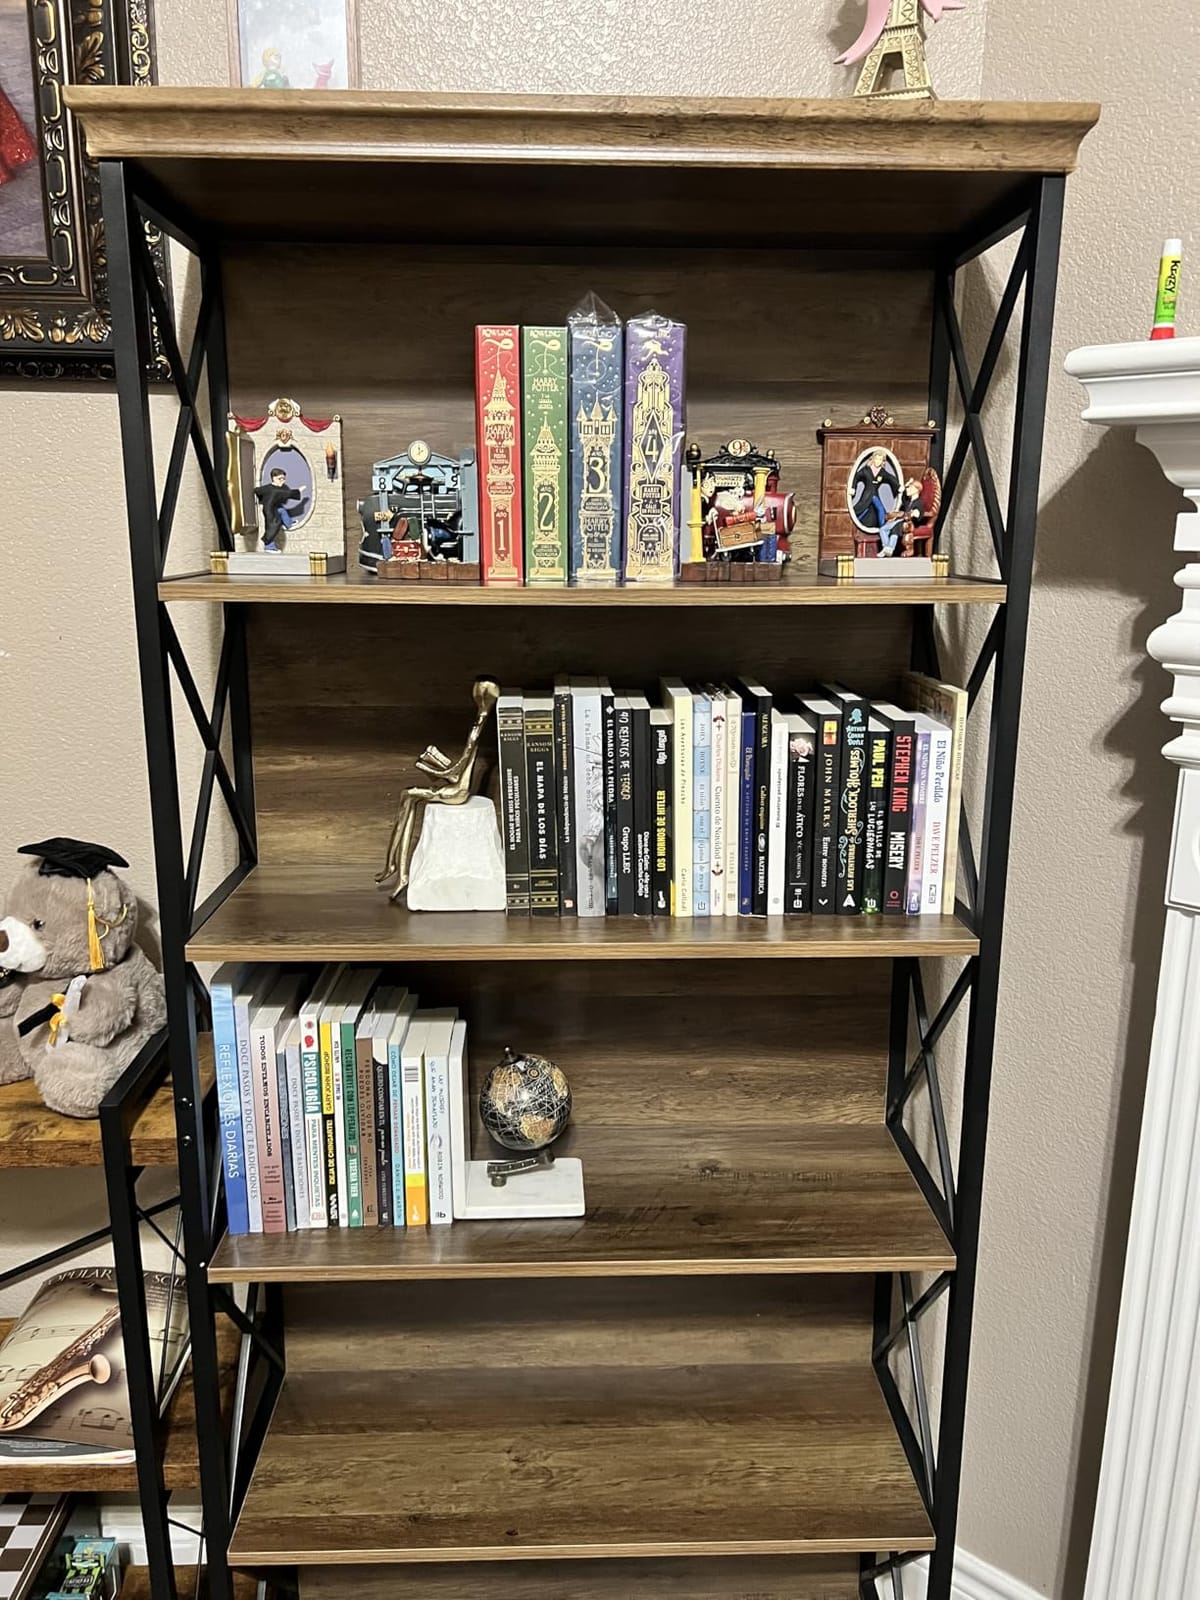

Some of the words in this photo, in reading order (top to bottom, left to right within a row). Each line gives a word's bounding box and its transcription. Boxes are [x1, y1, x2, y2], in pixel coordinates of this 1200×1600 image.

[533, 377, 558, 385] HARRY
[645, 435, 659, 462] 4
[378, 477, 386, 490] 8
[451, 474, 458, 487] 9
[588, 457, 606, 493] 3
[538, 493, 554, 531] 2
[497, 519, 506, 551] 1
[584, 709, 591, 718] La
[607, 719, 614, 727] EL
[618, 711, 629, 723] 40
[619, 726, 630, 757] RELATOS
[761, 713, 769, 748] ALFAGUARA
[872, 739, 886, 766] PAUL
[922, 743, 930, 751] EL
[937, 740, 947, 749] El
[536, 761, 544, 772] EL
[607, 766, 614, 775] LA
[619, 760, 630, 769] DE
[656, 752, 668, 765] Olga
[823, 752, 833, 783] JOHN
[846, 749, 861, 788] HOLMES
[893, 735, 912, 783] STEPHEN
[921, 752, 929, 768] NIÑO
[936, 751, 946, 770] Niño
[585, 768, 593, 785] debe
[680, 769, 687, 777] de
[796, 765, 806, 797] FLORES
[871, 768, 885, 788] PEN
[536, 775, 546, 800] MAPA
[620, 773, 631, 800] TERROR
[918, 780, 927, 804] NOMBRE
[933, 772, 945, 803] Perdido
[537, 803, 546, 815] DE
[656, 790, 666, 815] HITLER
[714, 785, 722, 815] Cuento
[823, 788, 832, 828] MARRS
[845, 787, 860, 836] SHERLOCK
[892, 787, 909, 812] KING
[538, 817, 546, 835] LOS
[656, 816, 666, 826] DE
[714, 816, 722, 826] de
[795, 812, 806, 838] ÁTICO
[878, 810, 884, 818] EL
[621, 826, 631, 851] Grupo
[656, 828, 666, 857] HORNOS
[714, 827, 722, 860] Navidad
[876, 820, 884, 847] BRILLO
[930, 822, 941, 843] DAVE
[537, 838, 547, 859] DÍAS
[822, 836, 831, 857] Entre
[875, 850, 883, 858] DE
[888, 831, 906, 870] MISERY
[929, 843, 940, 874] PELZER
[622, 852, 630, 874] LLEC
[657, 858, 666, 872] LOS
[820, 858, 829, 888] nosotras
[847, 844, 856, 879] AVENTURAS
[758, 856, 766, 895] BAZTERRICA
[846, 879, 855, 891] LAS
[239, 1039, 249, 1066] DOCE
[259, 1035, 267, 1061] TODOS
[390, 1050, 398, 1069] CÓMO
[260, 1062, 269, 1097] ESTAMOS
[344, 1048, 354, 1090] RECONSTRUYE
[376, 1065, 384, 1087] QUIERO
[218, 1044, 235, 1127] REFLEXIONES
[242, 1069, 251, 1096] PASOS
[303, 1053, 320, 1112] PSICOLOGÍA
[392, 1089, 398, 1097] DE
[346, 1090, 355, 1102] CON
[365, 1100, 372, 1109] LO
[377, 1087, 385, 1111] CONFIAR
[245, 1108, 254, 1135] DOCE
[347, 1103, 355, 1115] LOS
[378, 1111, 385, 1119] EN
[263, 1098, 273, 1157] ENCARCELADOS
[291, 1077, 299, 1098] DOCE
[297, 1152, 305, 1199] TRADICIONES
[347, 1115, 356, 1140] PEDAZOS
[367, 1133, 373, 1143] NO
[225, 1130, 239, 1178] DIARIAS
[311, 1139, 319, 1170] MENTES
[328, 1158, 335, 1167] DE
[246, 1137, 258, 1200] TRADICIONES
[313, 1170, 321, 1208] INQUIETAS
